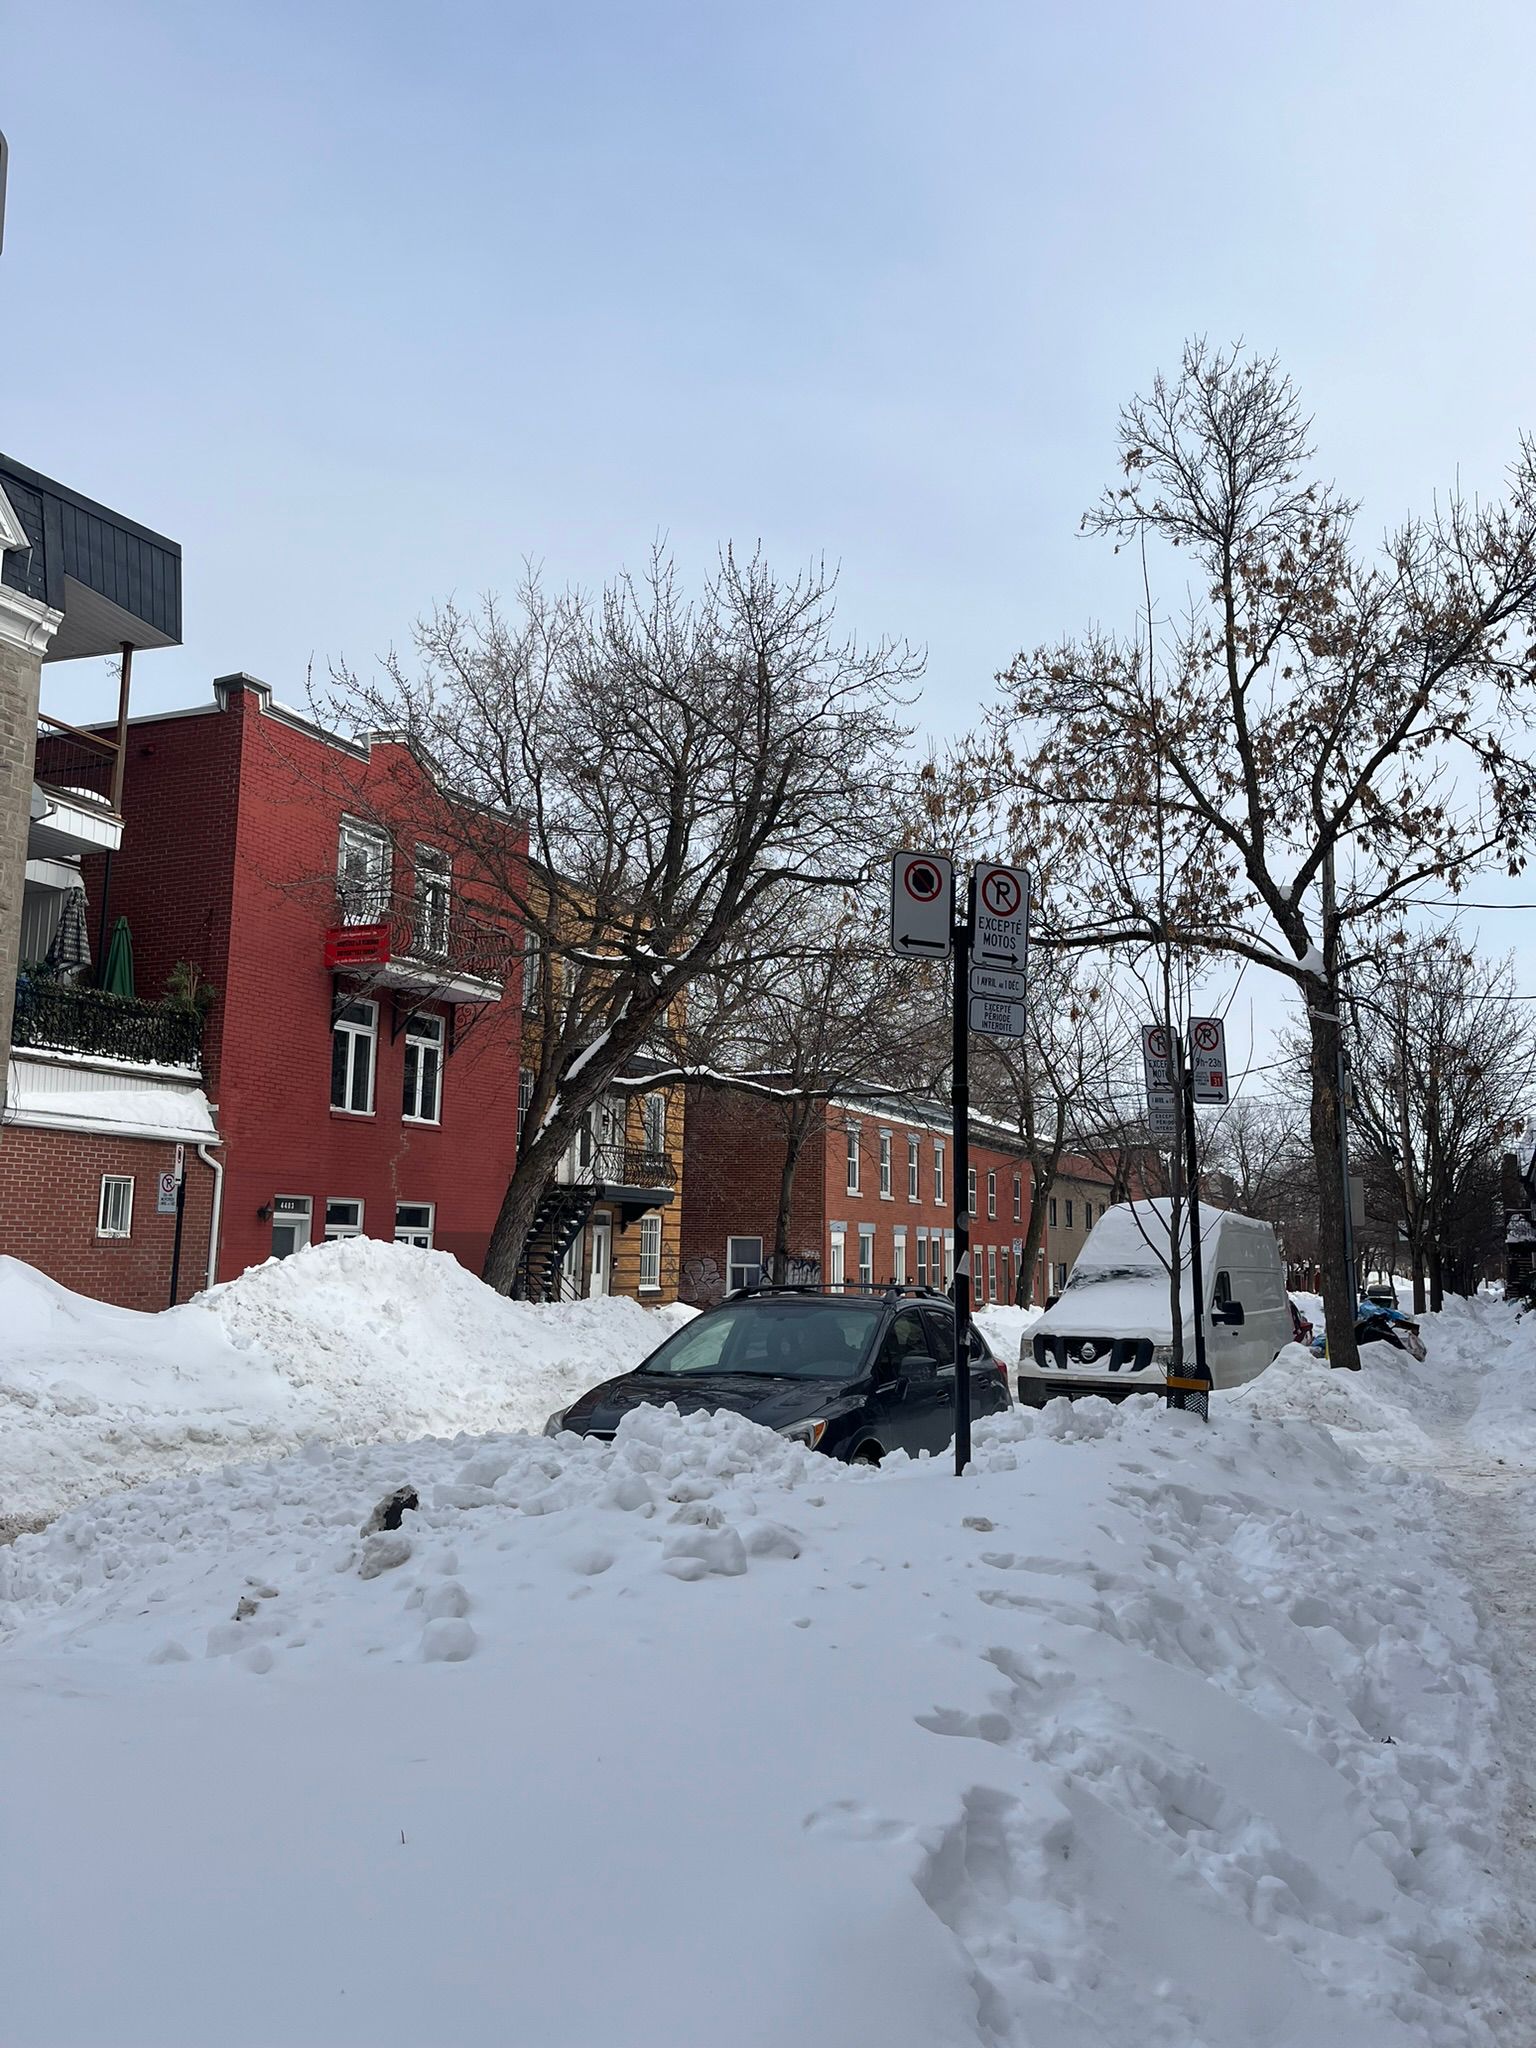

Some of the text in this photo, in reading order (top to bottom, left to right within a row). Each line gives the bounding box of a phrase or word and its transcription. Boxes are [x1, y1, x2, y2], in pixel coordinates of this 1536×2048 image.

[979, 916, 1022, 935] EXCEPTÉ
[983, 932, 1016, 949] MOTOS
[981, 976, 997, 987] AVRIL
[982, 1020, 1012, 1032] INTERDITE
